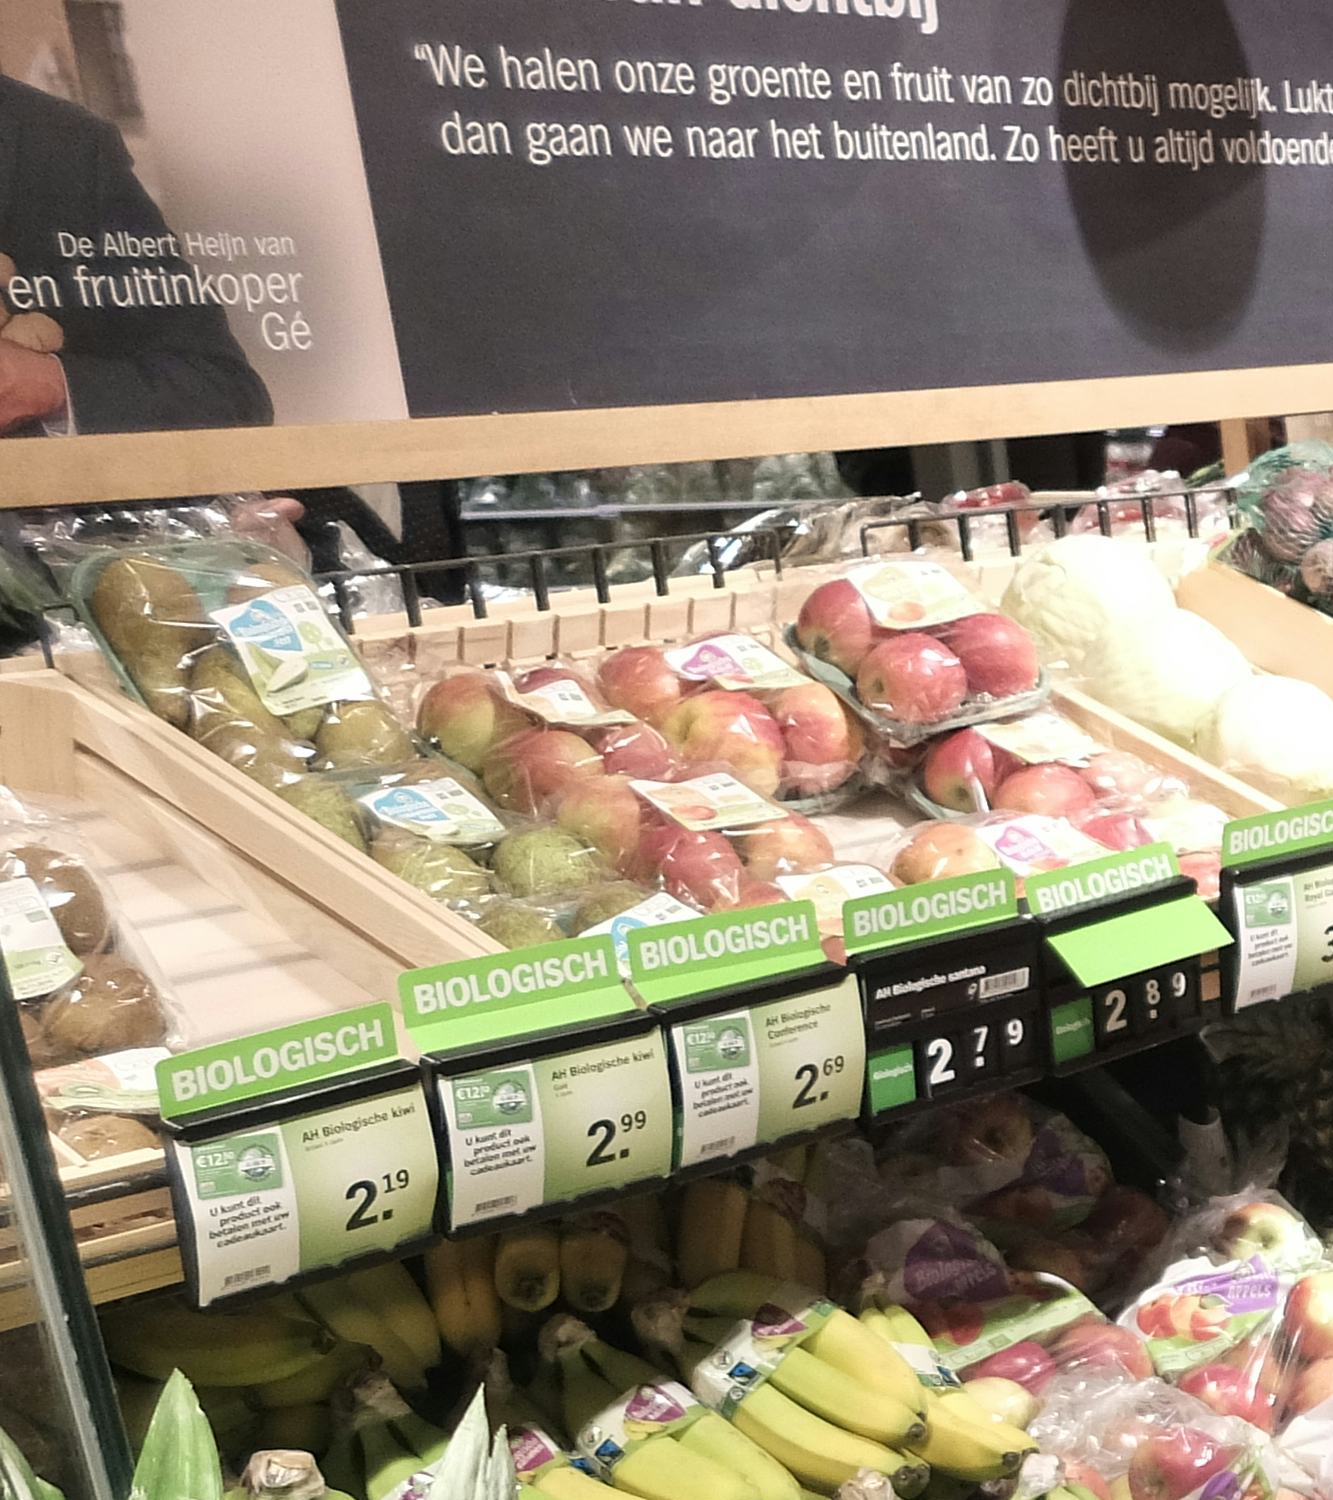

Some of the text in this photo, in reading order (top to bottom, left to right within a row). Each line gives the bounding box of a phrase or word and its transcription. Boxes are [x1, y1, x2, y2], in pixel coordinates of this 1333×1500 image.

[500, 49, 600, 93] halen
[614, 59, 696, 96] onze
[708, 61, 832, 105] groente
[844, 71, 880, 99] en
[891, 62, 954, 104] fruit
[960, 76, 1011, 105] van
[1022, 78, 1054, 106] zo
[1063, 72, 1160, 116] dichtbij
[1168, 77, 1277, 119] mogelijk.
[441, 112, 512, 155] dan
[526, 123, 612, 166] gaan
[624, 124, 674, 158] we
[686, 123, 756, 159] naar
[770, 118, 824, 162] het
[834, 119, 997, 162] buitenland.
[1004, 126, 1040, 162] Zo
[1050, 126, 1119, 163] heeft
[1128, 136, 1145, 163] u
[1154, 130, 1214, 171] altijd
[59, 230, 295, 263] De Albert Heijn van
[8, 266, 303, 313] en fruitinkoper
[261, 311, 312, 353] Gé
[853, 880, 1008, 937] BIOLOGISCH
[1036, 854, 1175, 913] BIOLOGISCH
[639, 913, 810, 971] BIOLOGISCH
[413, 949, 609, 1015] BIOLOGISCH
[172, 1018, 385, 1102] BIOLOGISCH
[570, 1057, 631, 1077] Biologische
[302, 1130, 319, 1144] AH
[322, 1111, 389, 1137] Biologische
[391, 1104, 416, 1120] kiwi
